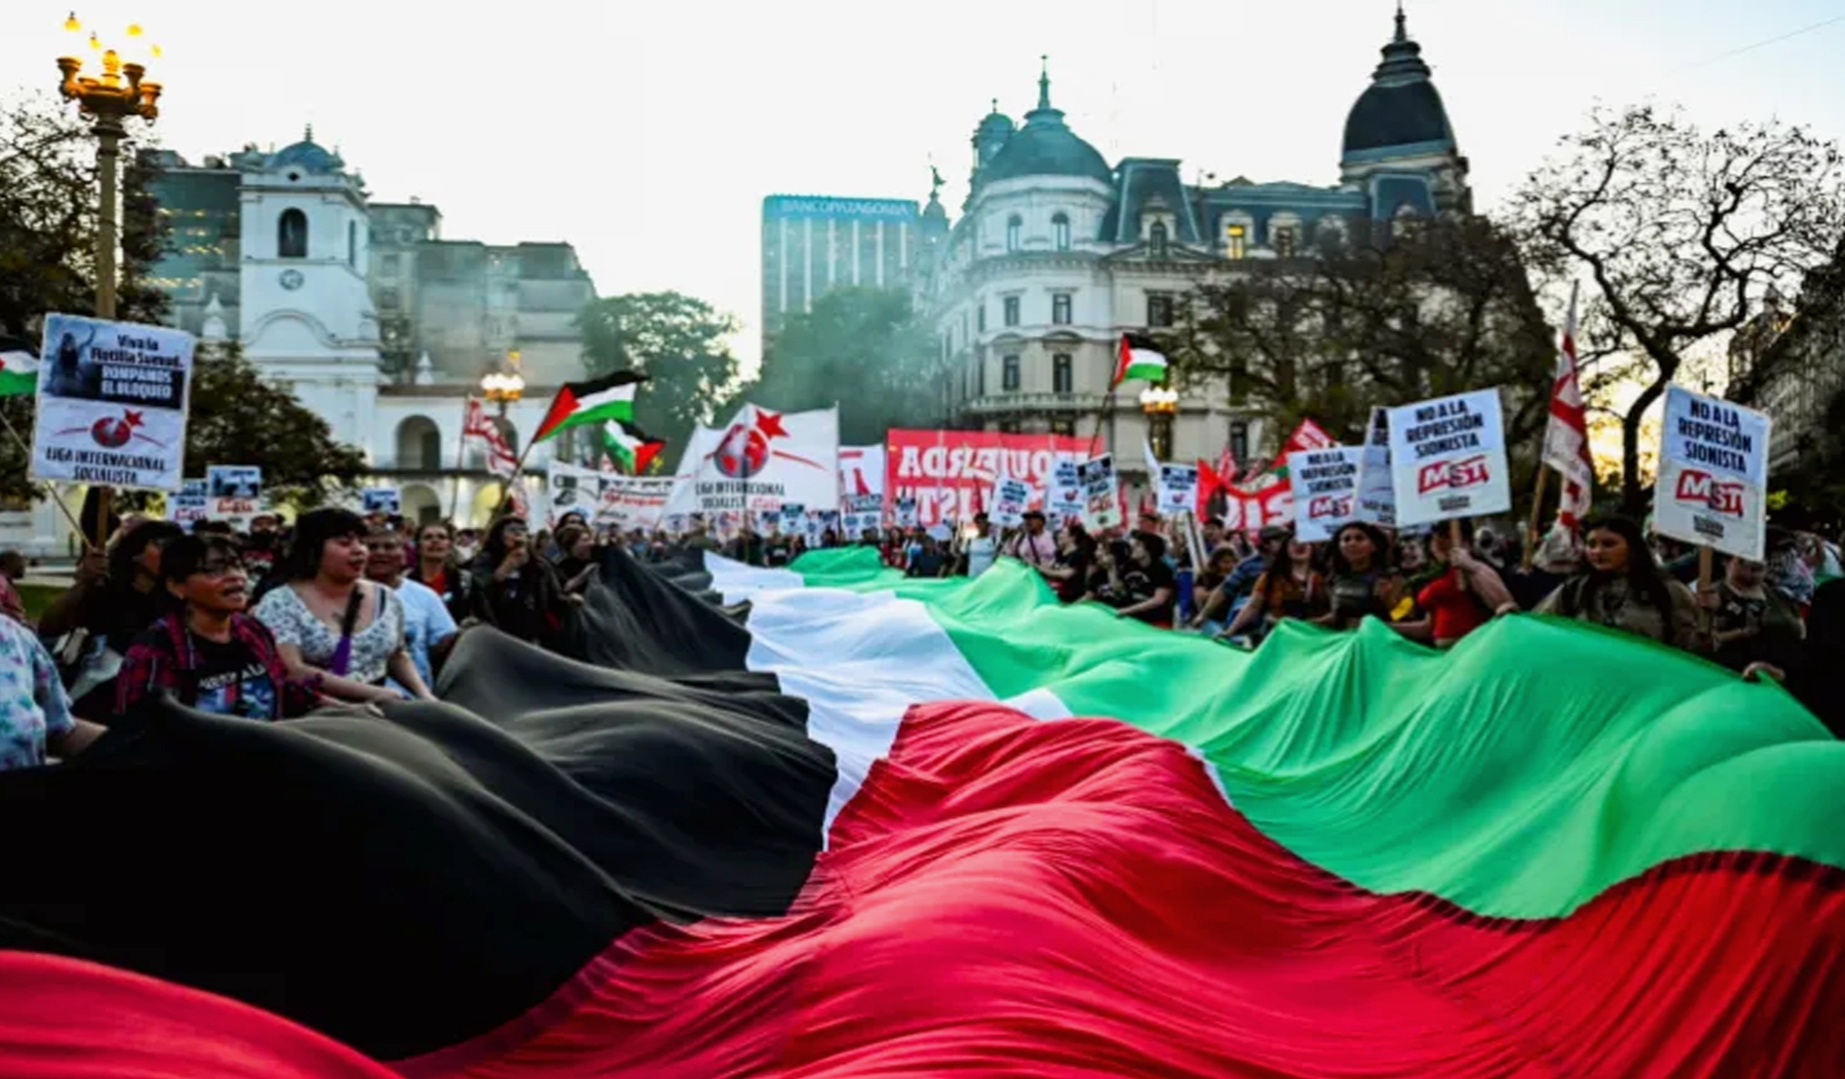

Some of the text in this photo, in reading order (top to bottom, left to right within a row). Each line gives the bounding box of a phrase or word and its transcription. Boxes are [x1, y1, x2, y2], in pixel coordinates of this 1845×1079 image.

[117, 334, 158, 351] Viva la
[102, 365, 172, 383] ROMPAMOS
[102, 380, 171, 399] EL BLOQUEO
[1416, 399, 1468, 422] NO A LA
[1690, 400, 1741, 431] NO A LA
[1405, 411, 1484, 443] REPRESIÓN
[1677, 417, 1752, 453] REPRESIÓN
[46, 446, 165, 470] LIGA INTERNACIONAL
[1415, 432, 1480, 458] SIONISTA
[1684, 440, 1747, 474] SIONISTA
[74, 465, 138, 484] SOCIALISTA
[1420, 457, 1487, 490] MST
[1679, 470, 1743, 513] MST
